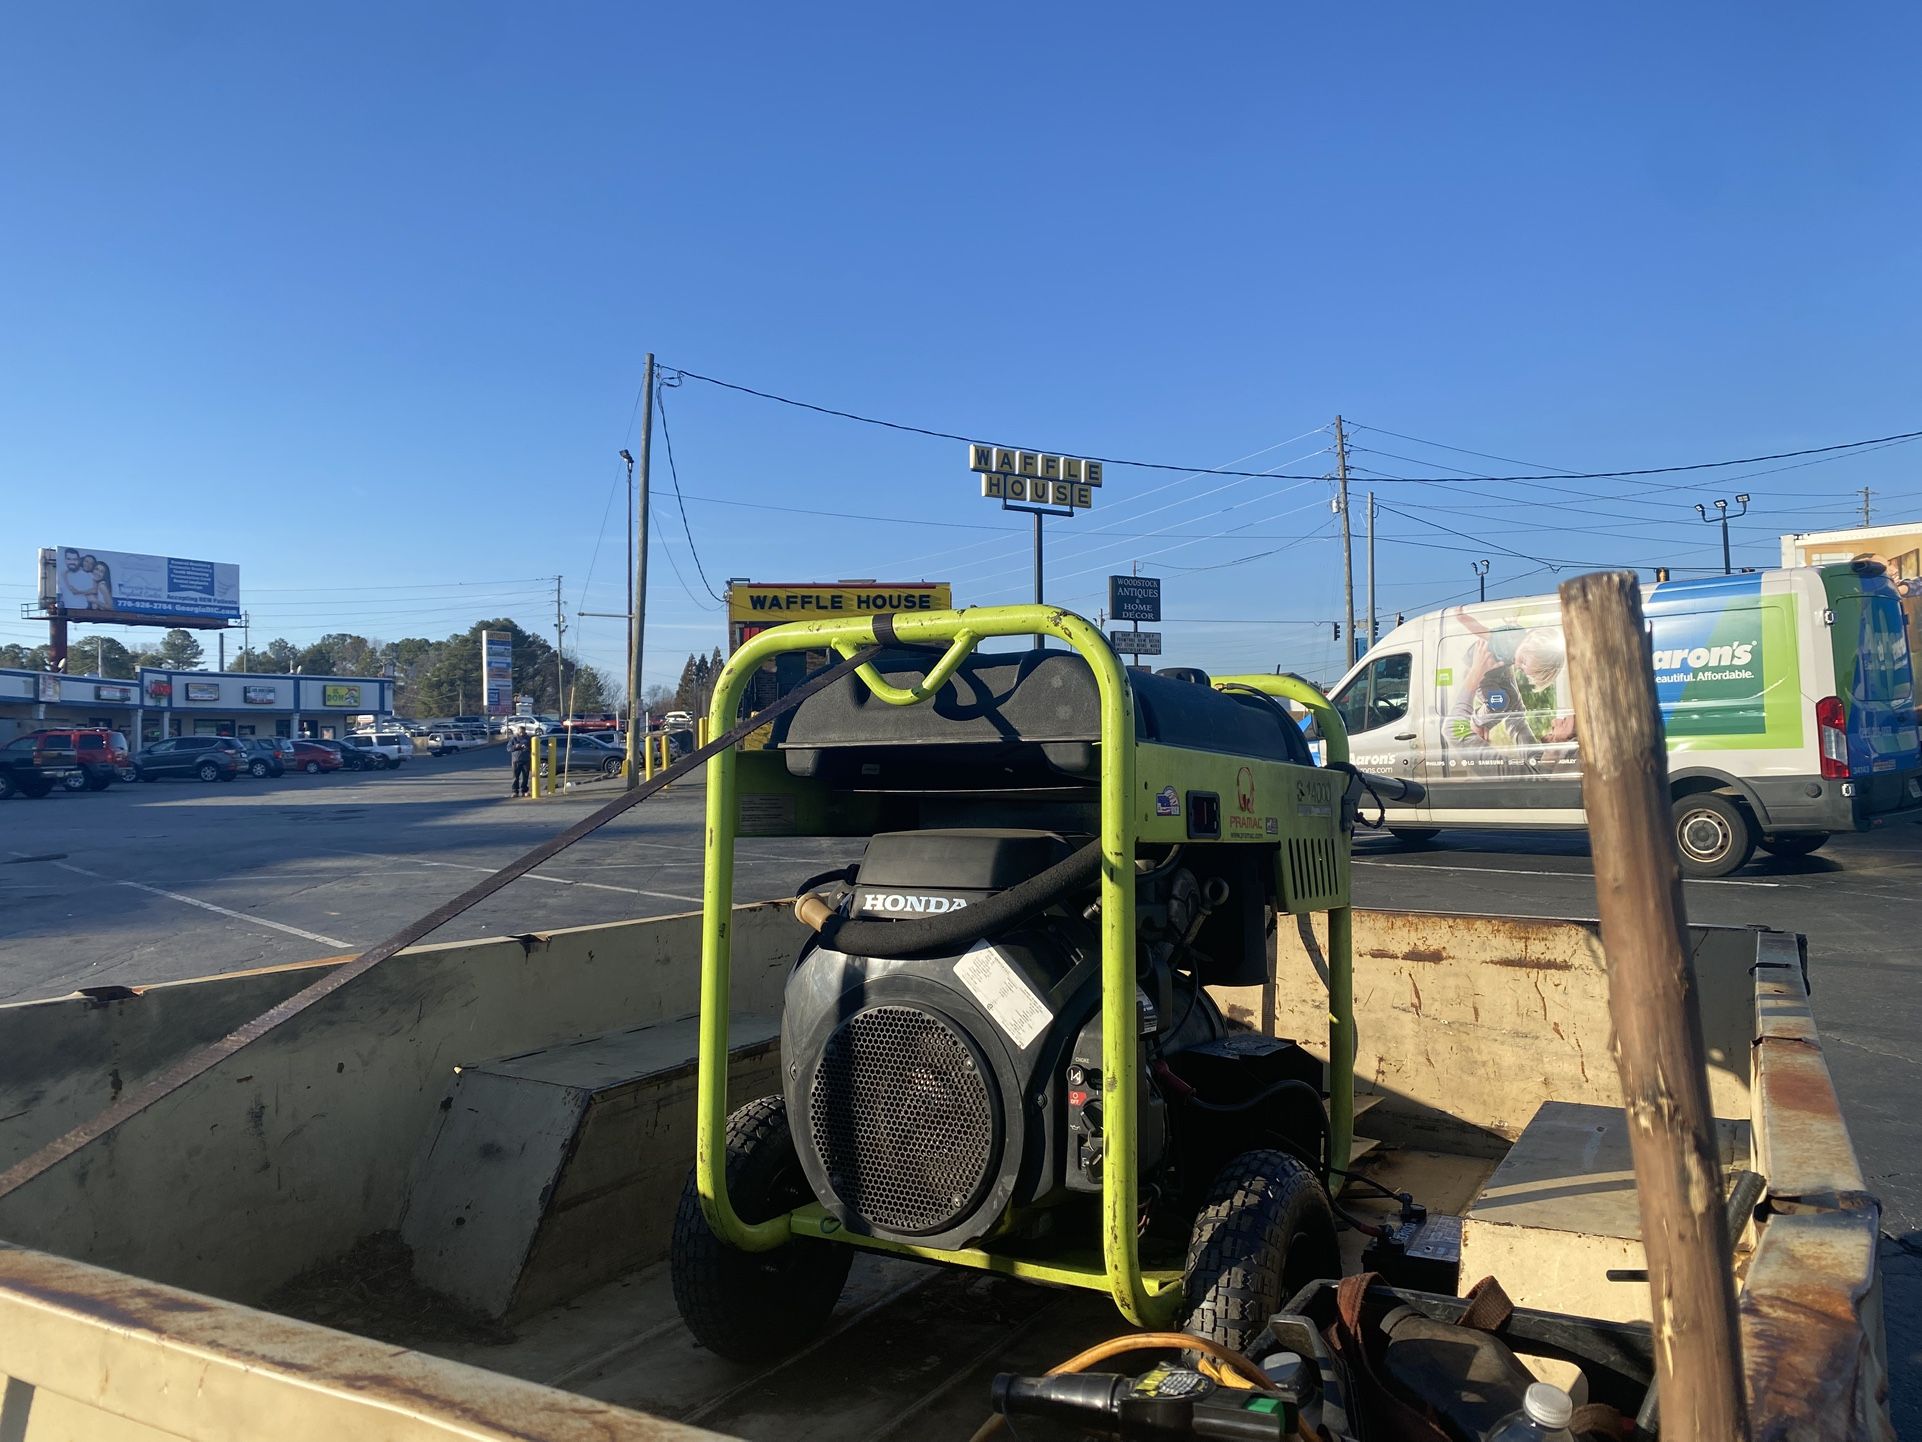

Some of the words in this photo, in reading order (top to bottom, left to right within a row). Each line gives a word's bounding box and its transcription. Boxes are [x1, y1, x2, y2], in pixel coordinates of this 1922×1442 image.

[974, 449, 1101, 481] WAFFLE
[988, 478, 1090, 505] HOUSE
[1117, 578, 1158, 588] WOODSTOCK
[1117, 588, 1159, 598] ANTIQUES
[749, 593, 843, 611] WAFFLE
[857, 593, 932, 610] HOUSE
[1124, 603, 1153, 611] HOME
[1653, 640, 1754, 671] aron's
[1655, 672, 1696, 683] eautiful.
[1697, 669, 1755, 681] Affordable.
[1229, 815, 1263, 829] PRAMAC
[862, 893, 968, 914] HONDA
